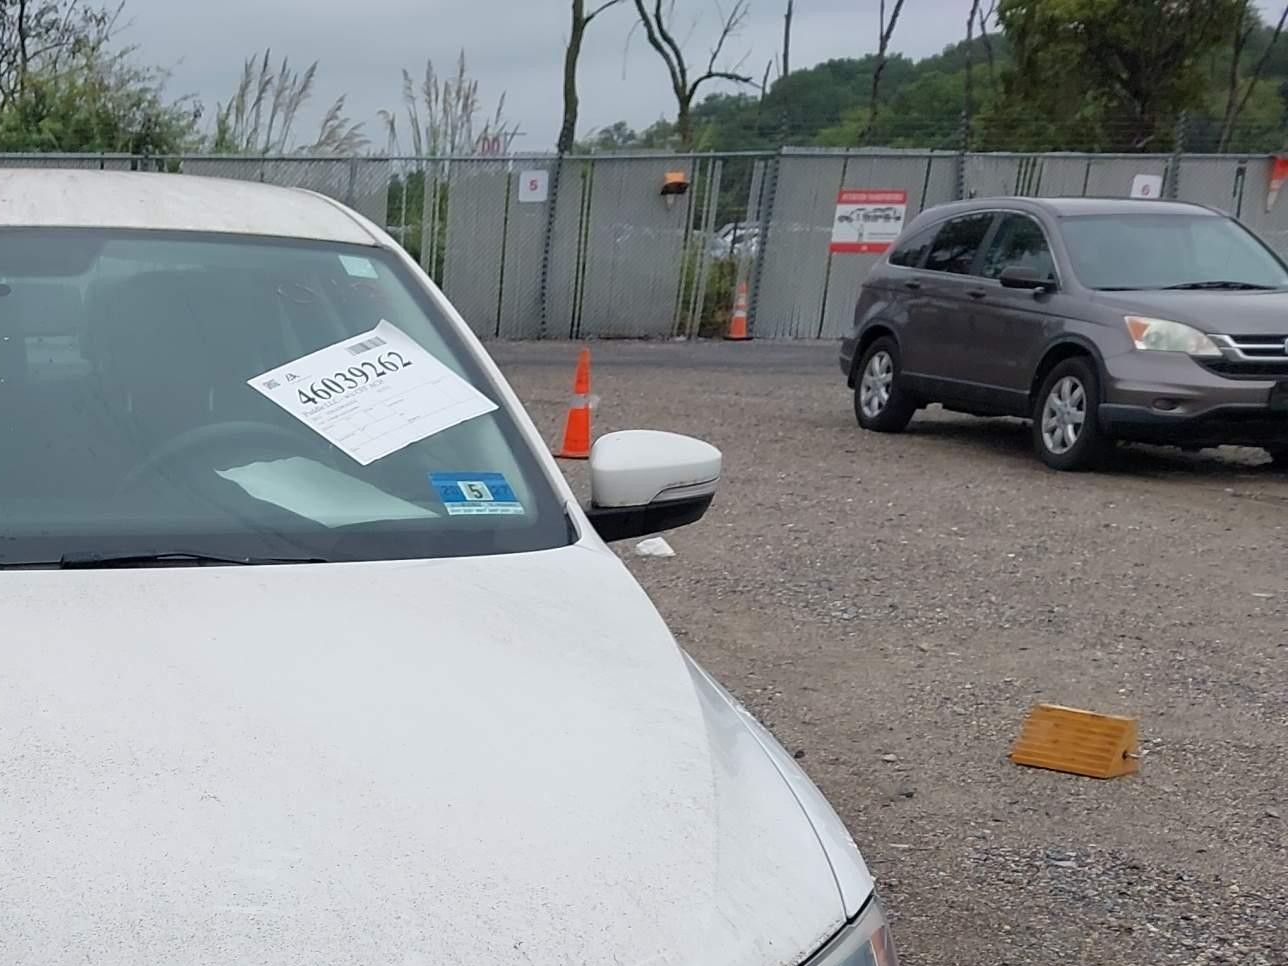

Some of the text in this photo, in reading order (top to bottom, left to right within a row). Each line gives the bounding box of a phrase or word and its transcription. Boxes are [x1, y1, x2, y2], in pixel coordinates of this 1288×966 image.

[529, 180, 539, 191] 5
[1141, 184, 1151, 196] 6
[298, 351, 412, 404] 46039262
[467, 483, 483, 499] 5
